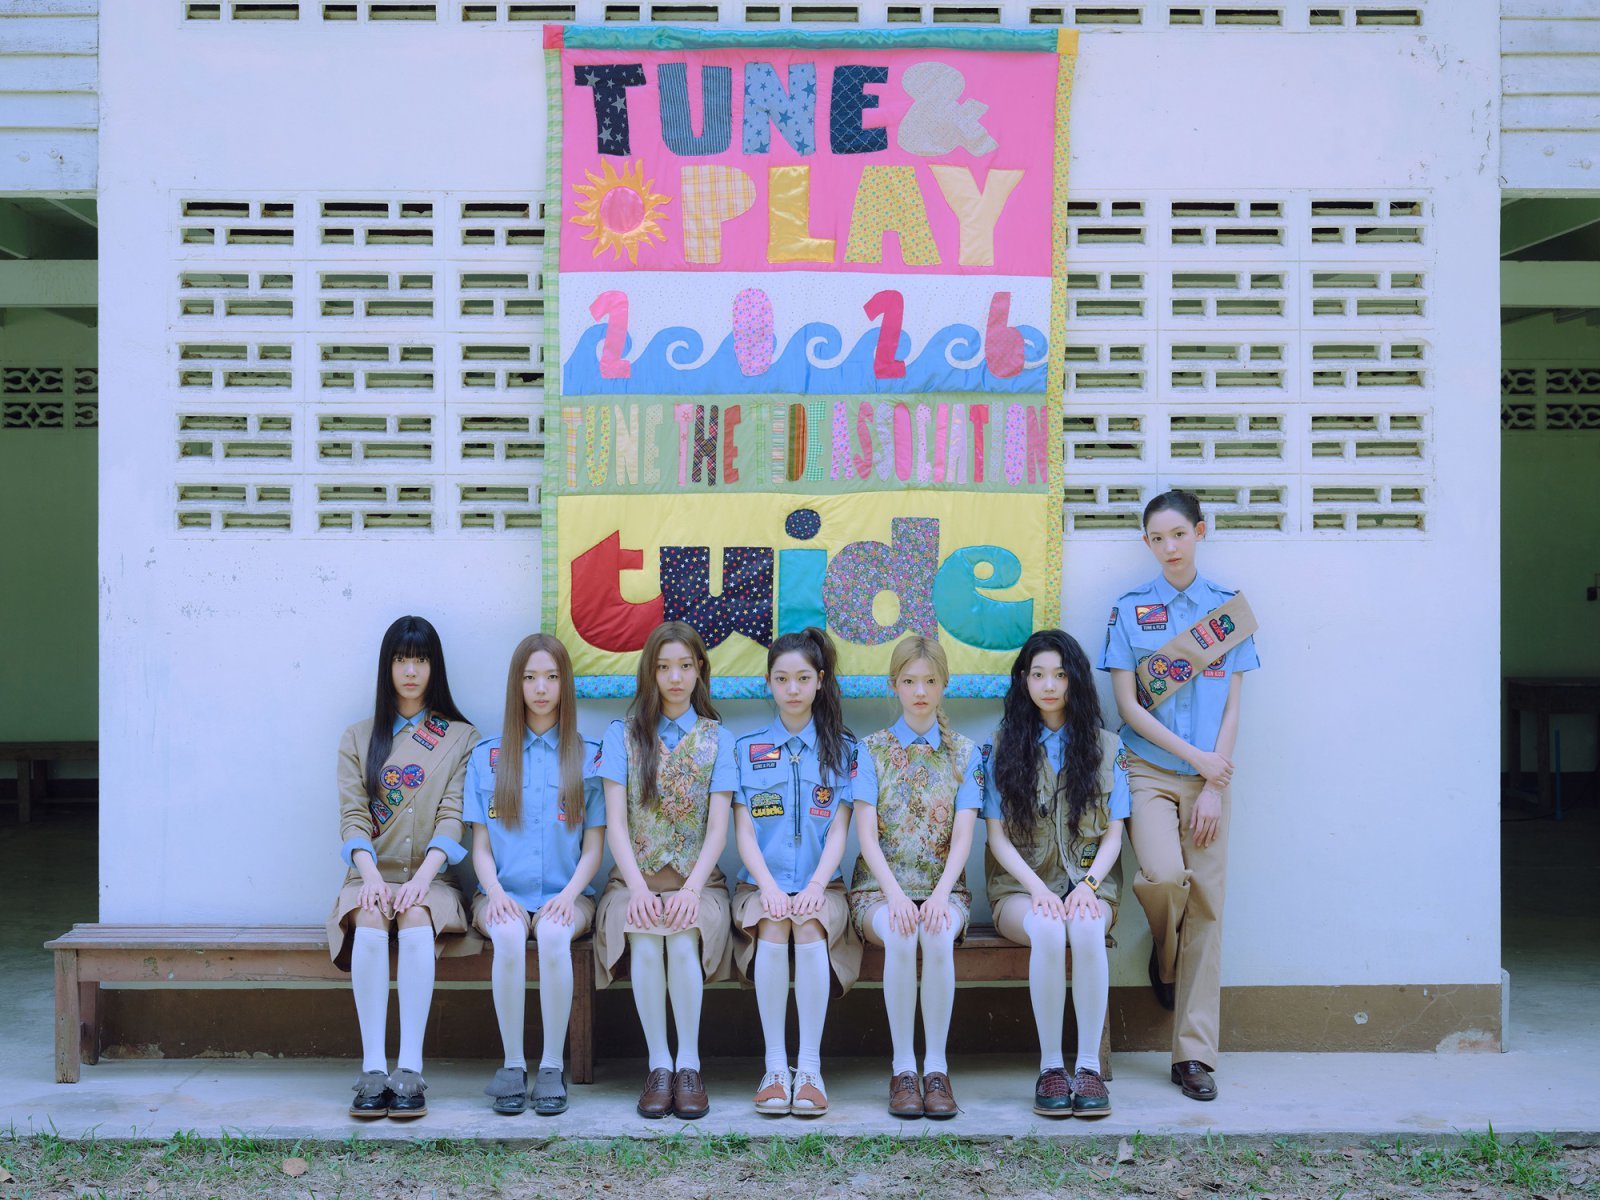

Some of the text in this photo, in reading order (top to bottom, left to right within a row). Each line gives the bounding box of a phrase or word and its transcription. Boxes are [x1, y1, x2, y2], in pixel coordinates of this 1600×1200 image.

[574, 61, 999, 157] TUNE &
[680, 165, 1025, 266] PLAY
[561, 400, 1048, 487] TUNE THE TIDE ASSOCIATION
